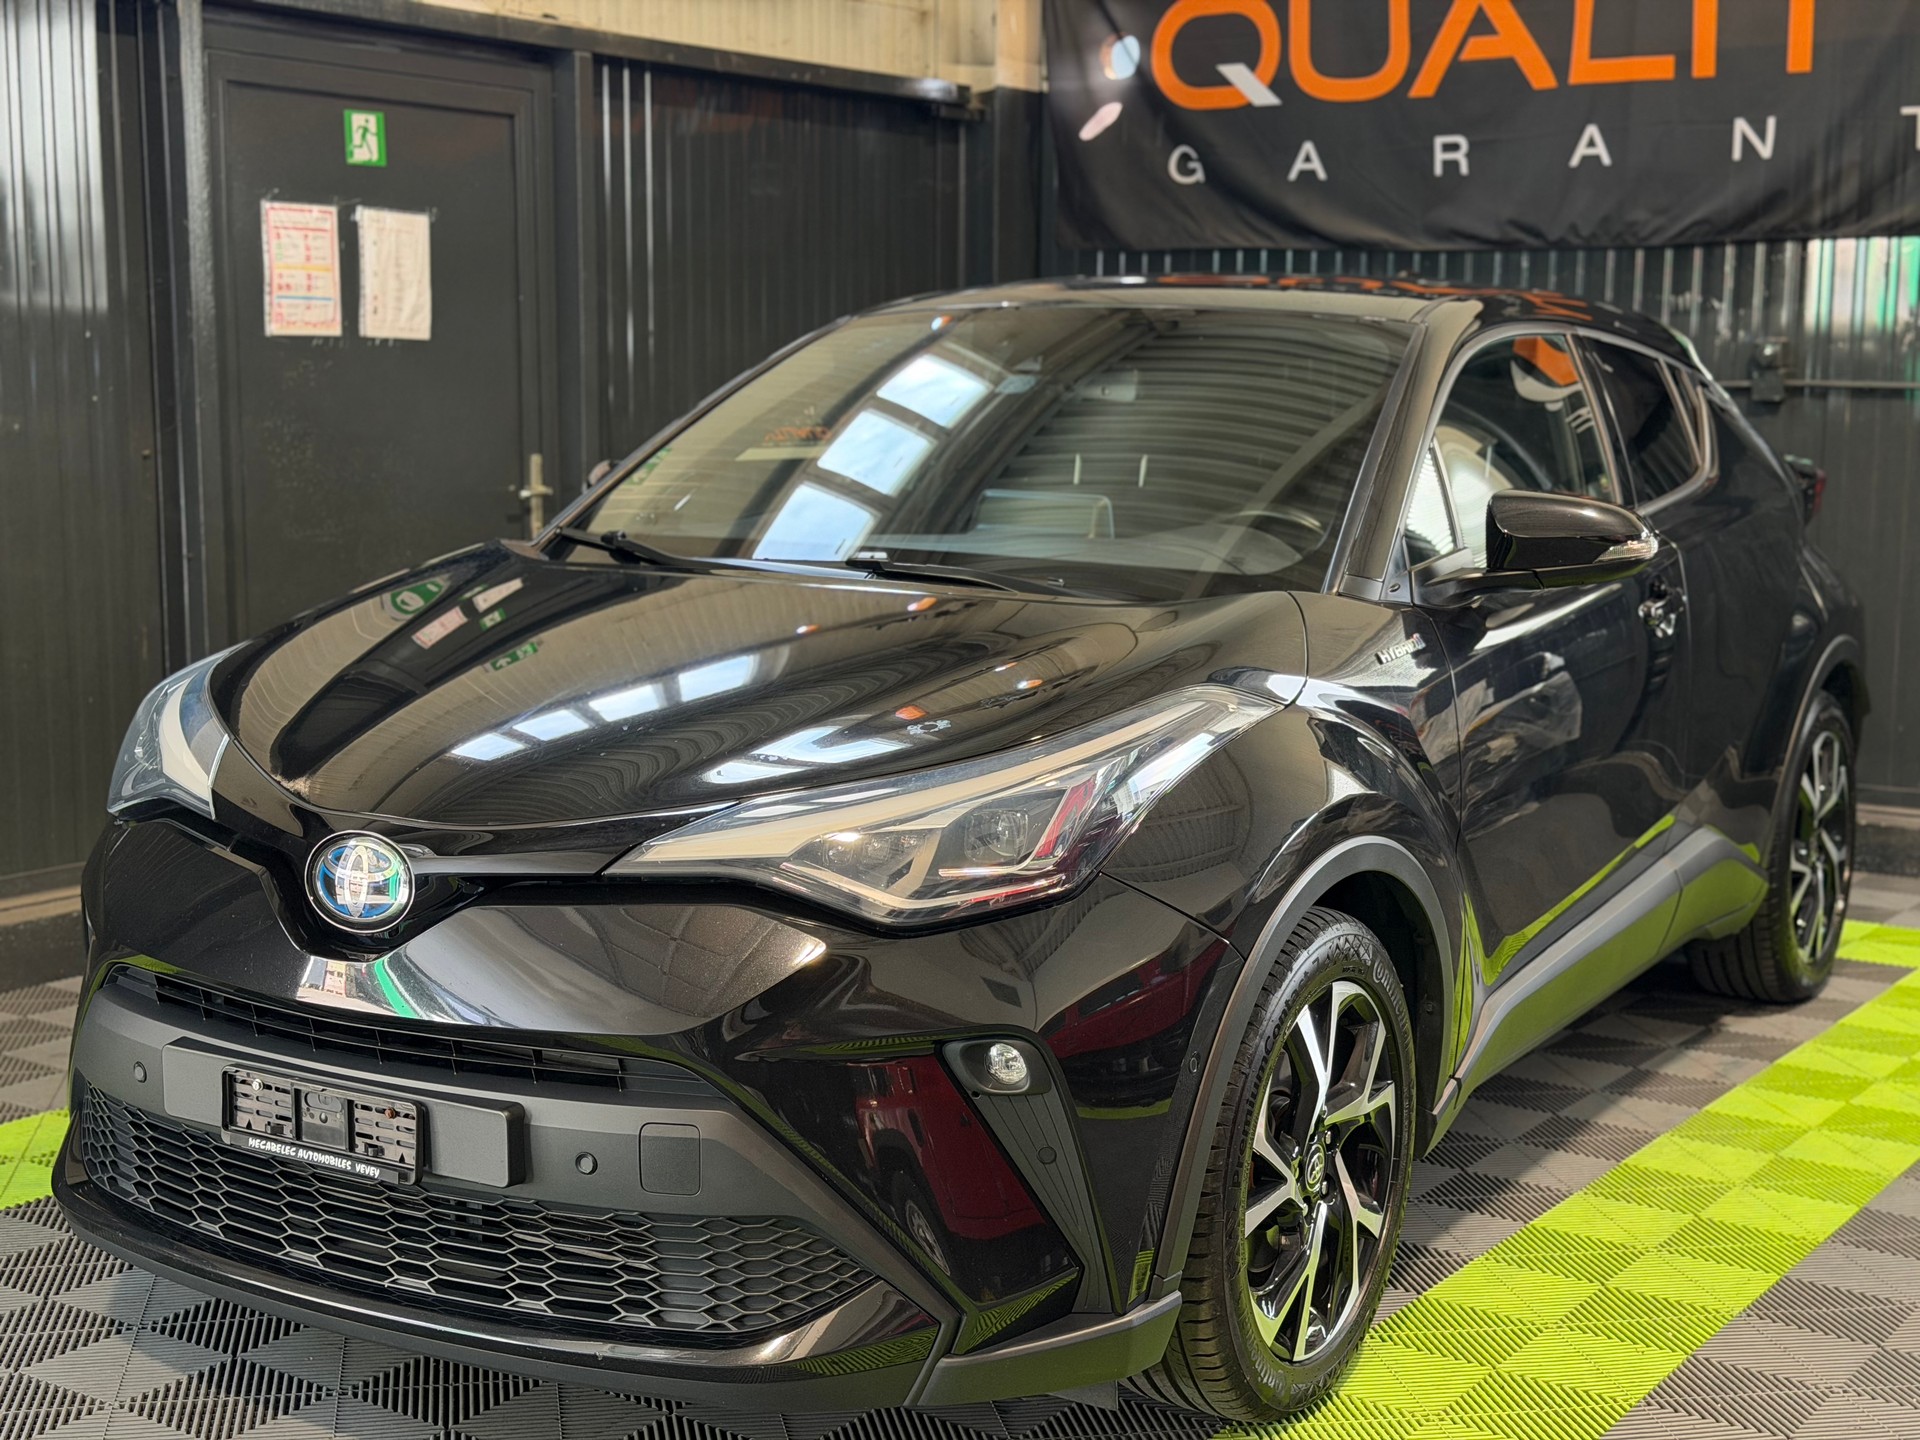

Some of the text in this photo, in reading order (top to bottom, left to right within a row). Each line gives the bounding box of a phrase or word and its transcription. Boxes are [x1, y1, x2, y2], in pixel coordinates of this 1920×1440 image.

[1376, 632, 1426, 665] HYBRID
[248, 1136, 380, 1178] MECABELEC AUTOMOBILES VEVEY
